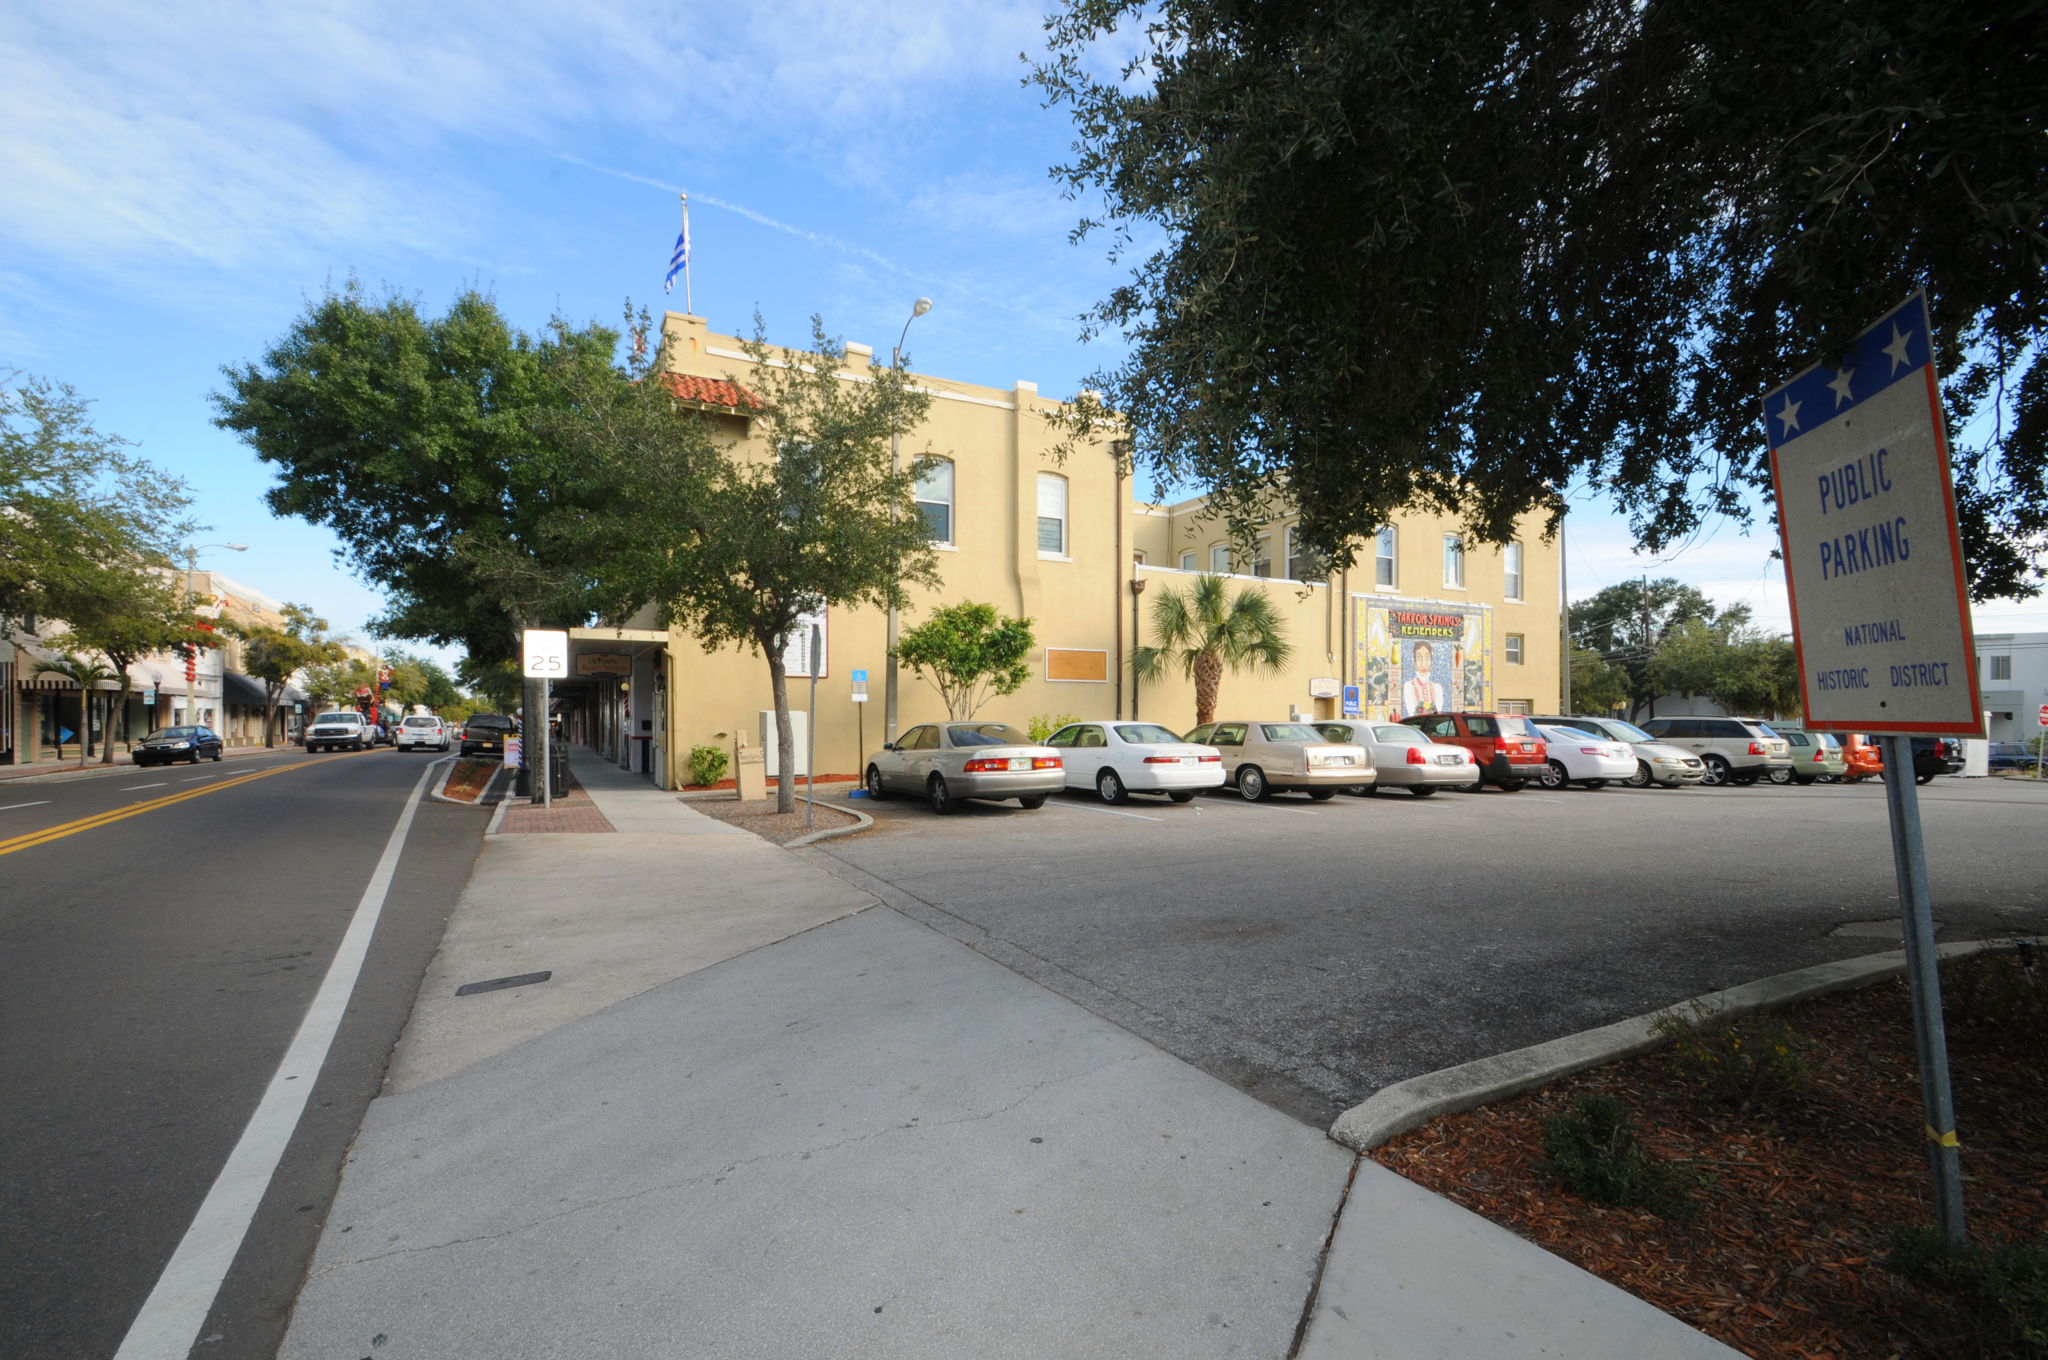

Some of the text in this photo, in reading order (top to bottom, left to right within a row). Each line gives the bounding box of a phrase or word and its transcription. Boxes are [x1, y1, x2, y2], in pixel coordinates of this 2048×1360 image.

[1818, 448, 1892, 515] PUBLIC
[1819, 517, 1910, 581] PARKING
[1396, 612, 1459, 627] TARPON SPRINGS
[1401, 626, 1454, 637] REMEMBERS
[1844, 619, 1906, 647] NATIONAL
[531, 656, 561, 671] 25
[1817, 662, 1949, 691] HISTORIC DISTRICT
